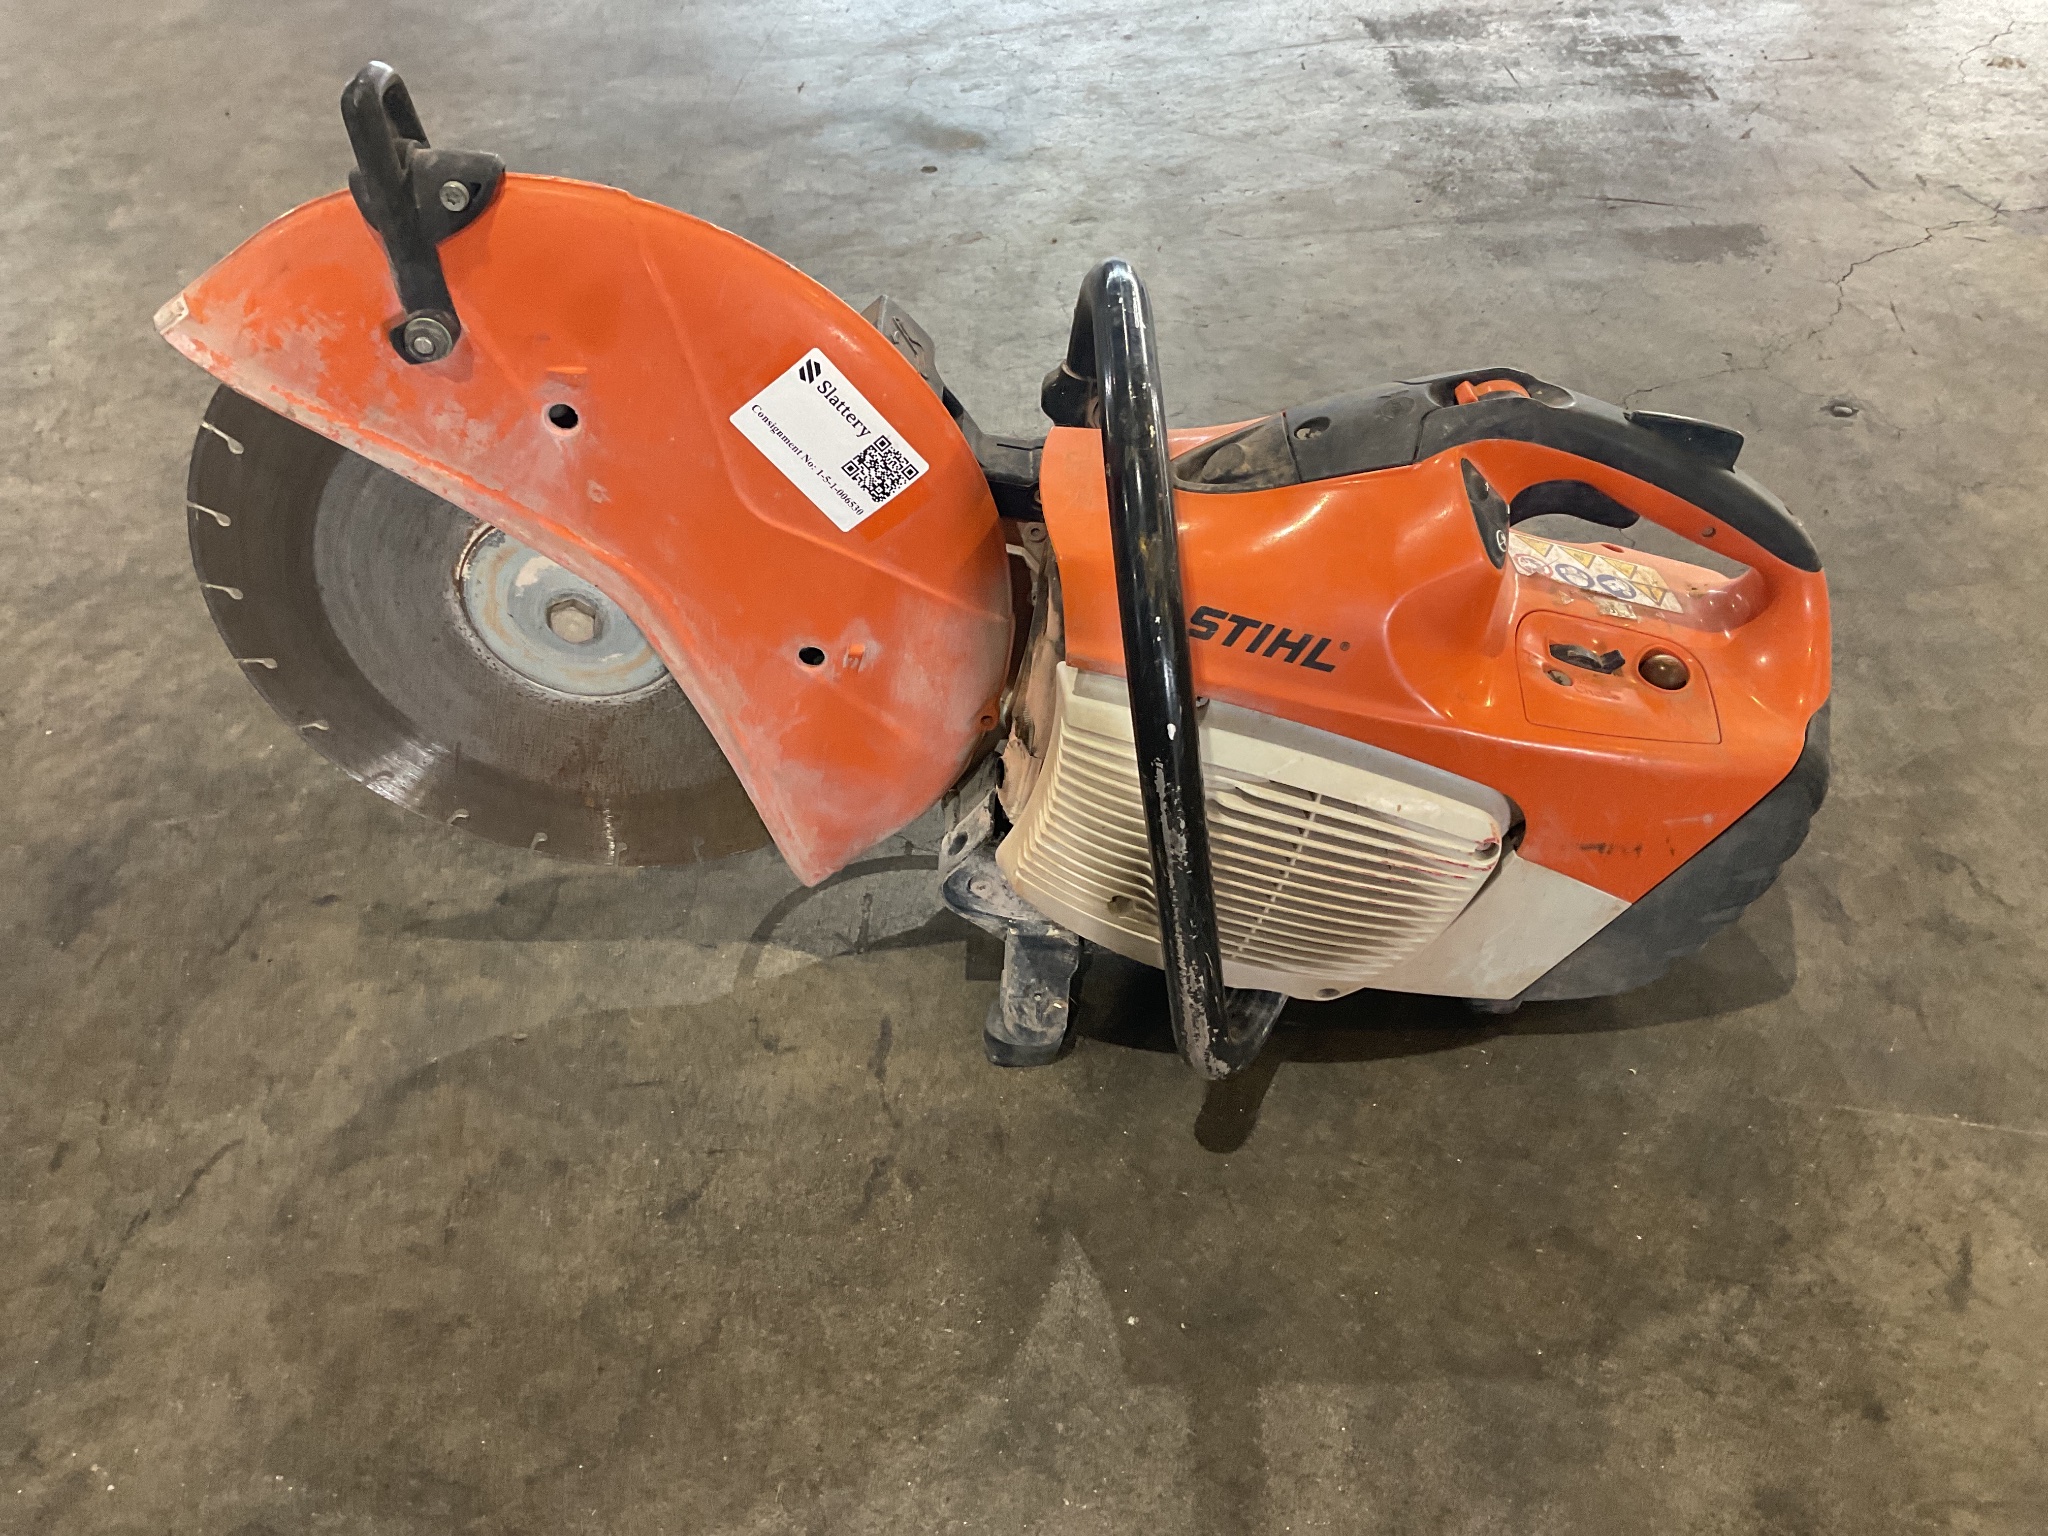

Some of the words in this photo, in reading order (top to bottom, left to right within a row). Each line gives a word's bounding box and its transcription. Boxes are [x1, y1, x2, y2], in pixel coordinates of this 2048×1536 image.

[817, 380, 871, 438] Slattery
[751, 404, 803, 456] Consignment
[801, 454, 817, 470] No:
[816, 469, 864, 516] 1-5-1-006530
[1188, 605, 1336, 673] STIHL
